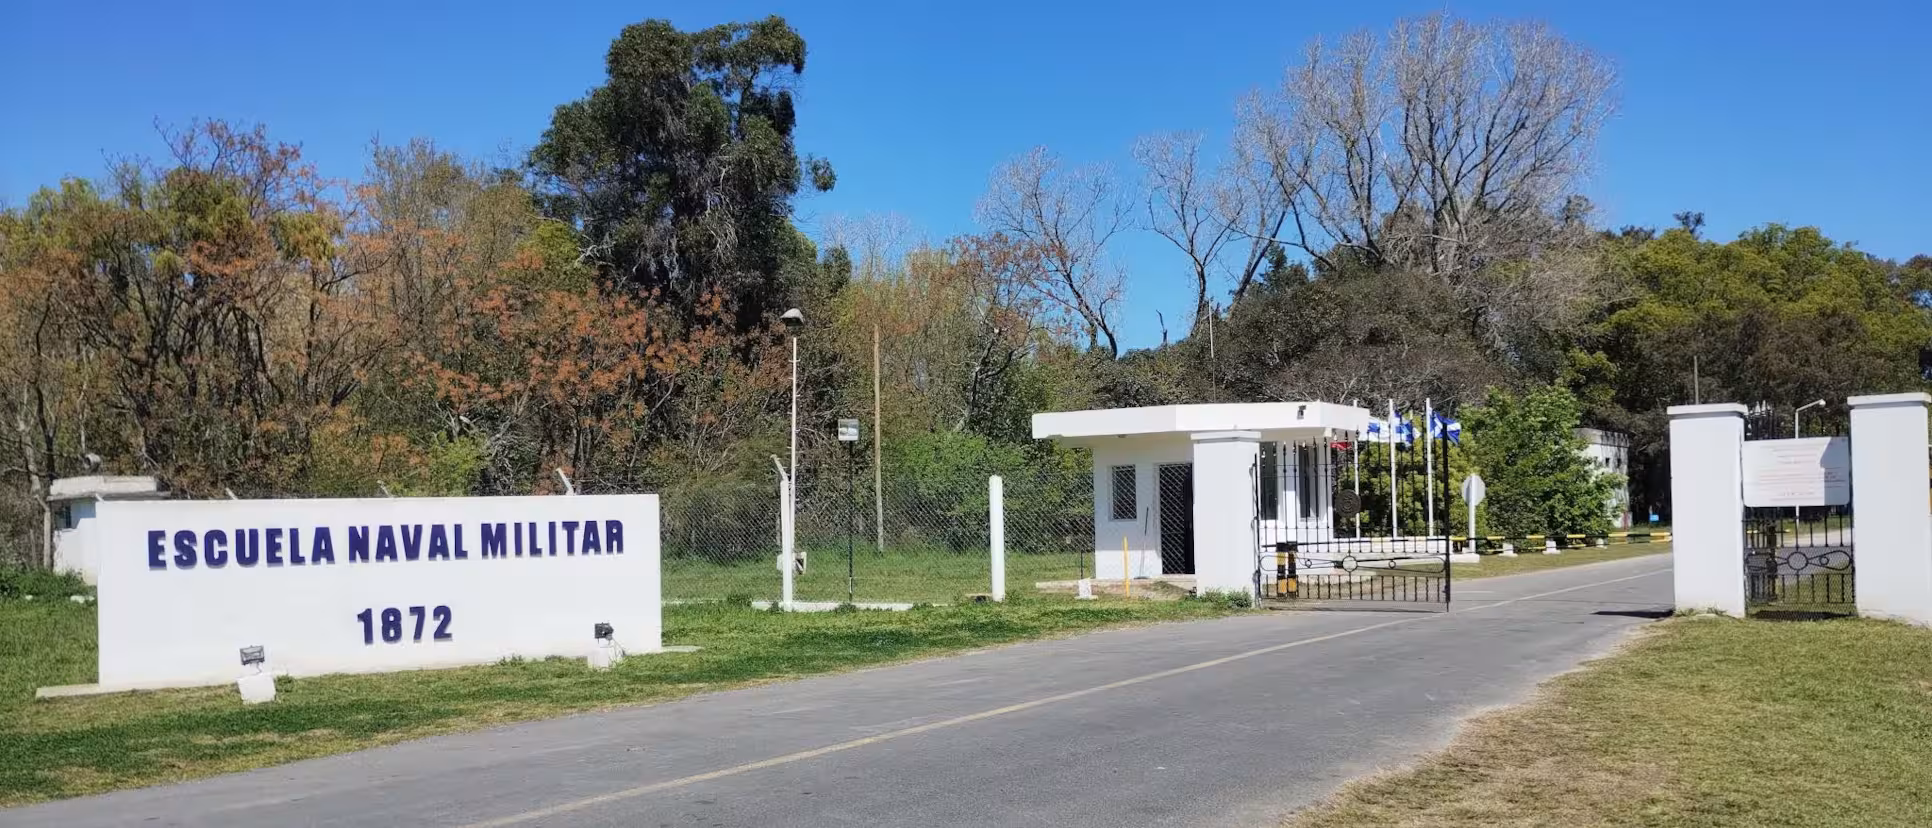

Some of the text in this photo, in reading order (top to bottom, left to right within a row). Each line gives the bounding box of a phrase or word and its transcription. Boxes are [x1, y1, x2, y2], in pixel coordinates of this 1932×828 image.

[147, 519, 625, 569] ESCUELA NAVAL MILITAR
[357, 605, 453, 645] 1872
